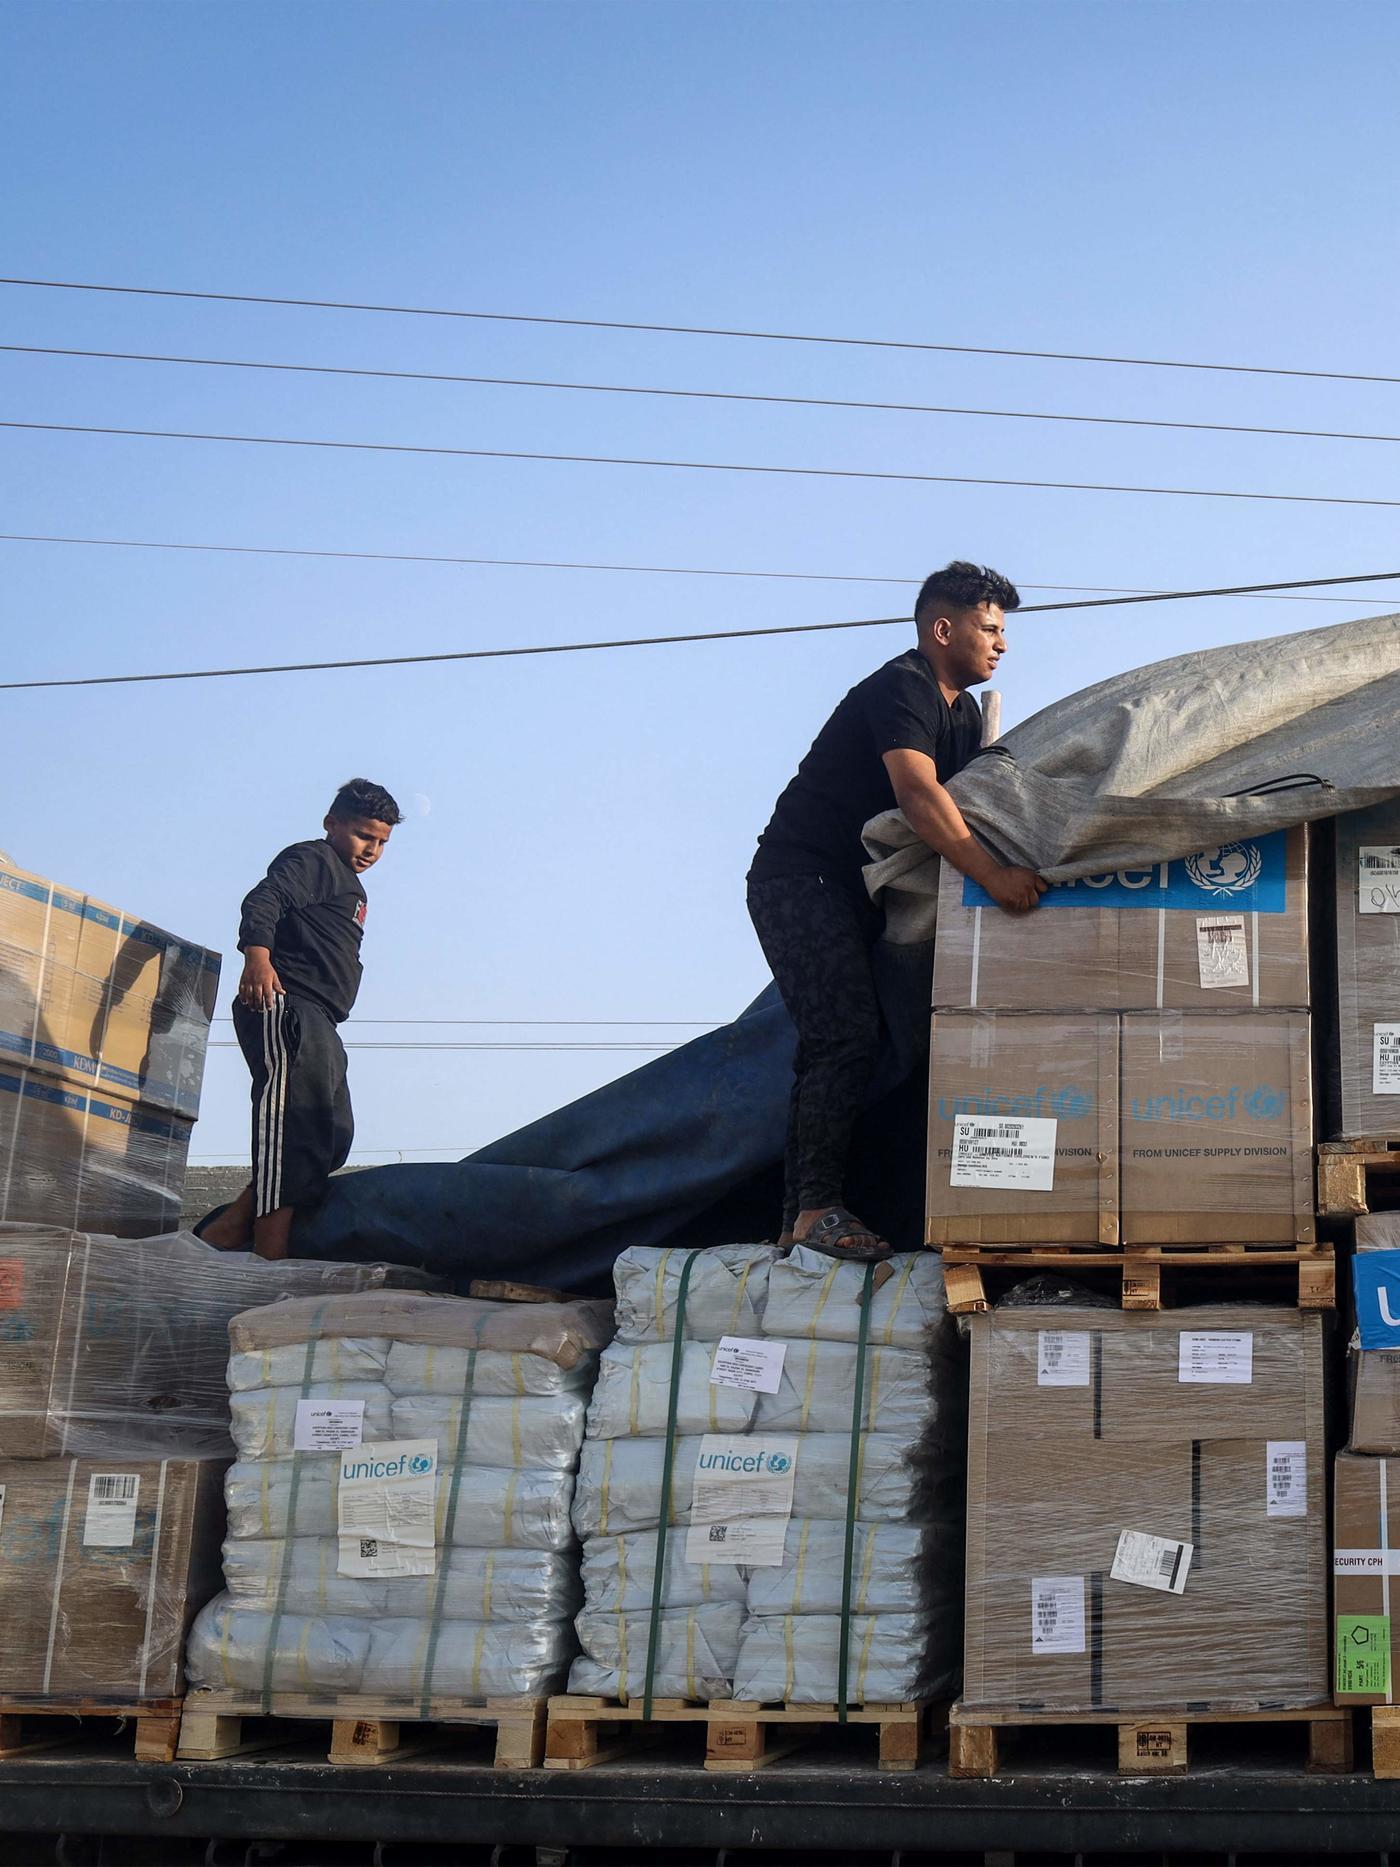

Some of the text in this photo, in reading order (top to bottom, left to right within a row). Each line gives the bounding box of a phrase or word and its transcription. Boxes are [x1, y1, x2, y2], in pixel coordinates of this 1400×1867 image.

[1380, 1036, 1390, 1046] SU
[938, 1084, 1047, 1120] unicef
[1131, 1086, 1239, 1122] unicef
[960, 1127, 970, 1136] SU
[959, 1144, 969, 1152] HU
[1133, 1147, 1287, 1158] FROM UNICEF SUPPLY DIVISION
[699, 1449, 766, 1473] unicef
[344, 1455, 407, 1481] unicef
[1367, 1557, 1383, 1566] CPH
